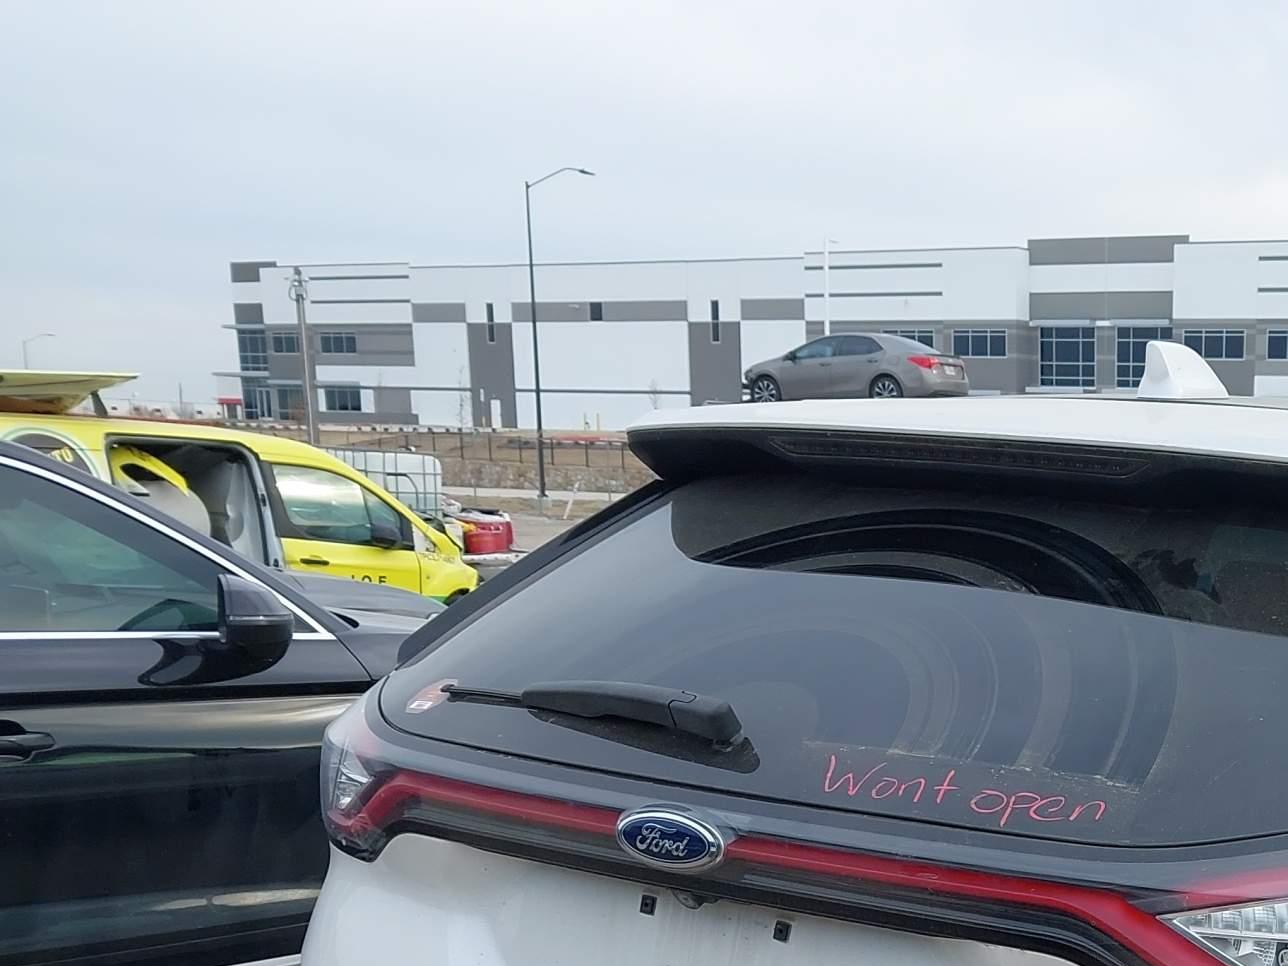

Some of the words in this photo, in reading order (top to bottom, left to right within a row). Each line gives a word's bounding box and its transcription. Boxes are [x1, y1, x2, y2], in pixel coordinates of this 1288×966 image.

[823, 754, 961, 806] Wont
[969, 789, 1108, 828] open
[635, 822, 689, 858] Ford
